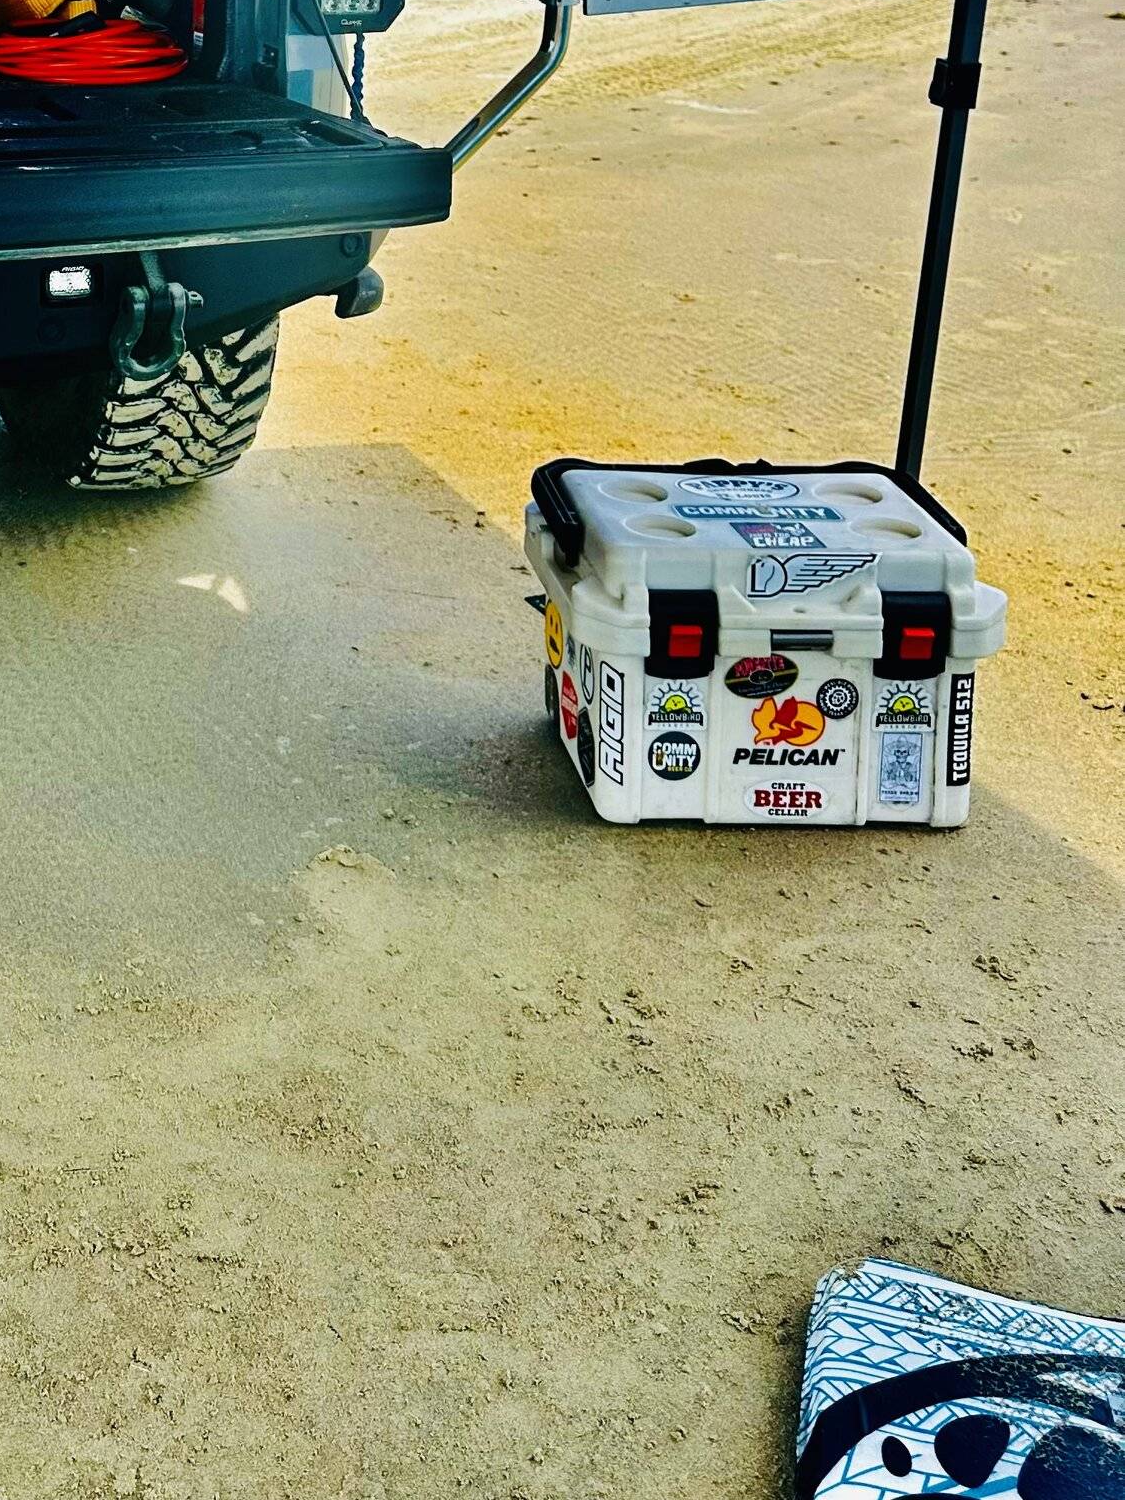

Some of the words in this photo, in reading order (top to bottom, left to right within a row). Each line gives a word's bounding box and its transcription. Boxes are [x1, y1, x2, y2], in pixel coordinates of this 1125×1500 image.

[685, 478, 789, 491] PAPPY'S
[682, 504, 827, 519] COMMUNITY
[955, 678, 972, 711] 512
[599, 660, 625, 786] RIGID
[651, 713, 701, 722] YELLOWBIRD
[878, 714, 929, 723] YELLOWBIRD
[652, 741, 697, 755] COMM
[952, 714, 970, 782] TEQUILA
[732, 748, 841, 766] PELICAN
[771, 782, 806, 790] CRAFT
[753, 789, 823, 809] BEER
[767, 808, 809, 817] CELLAR
